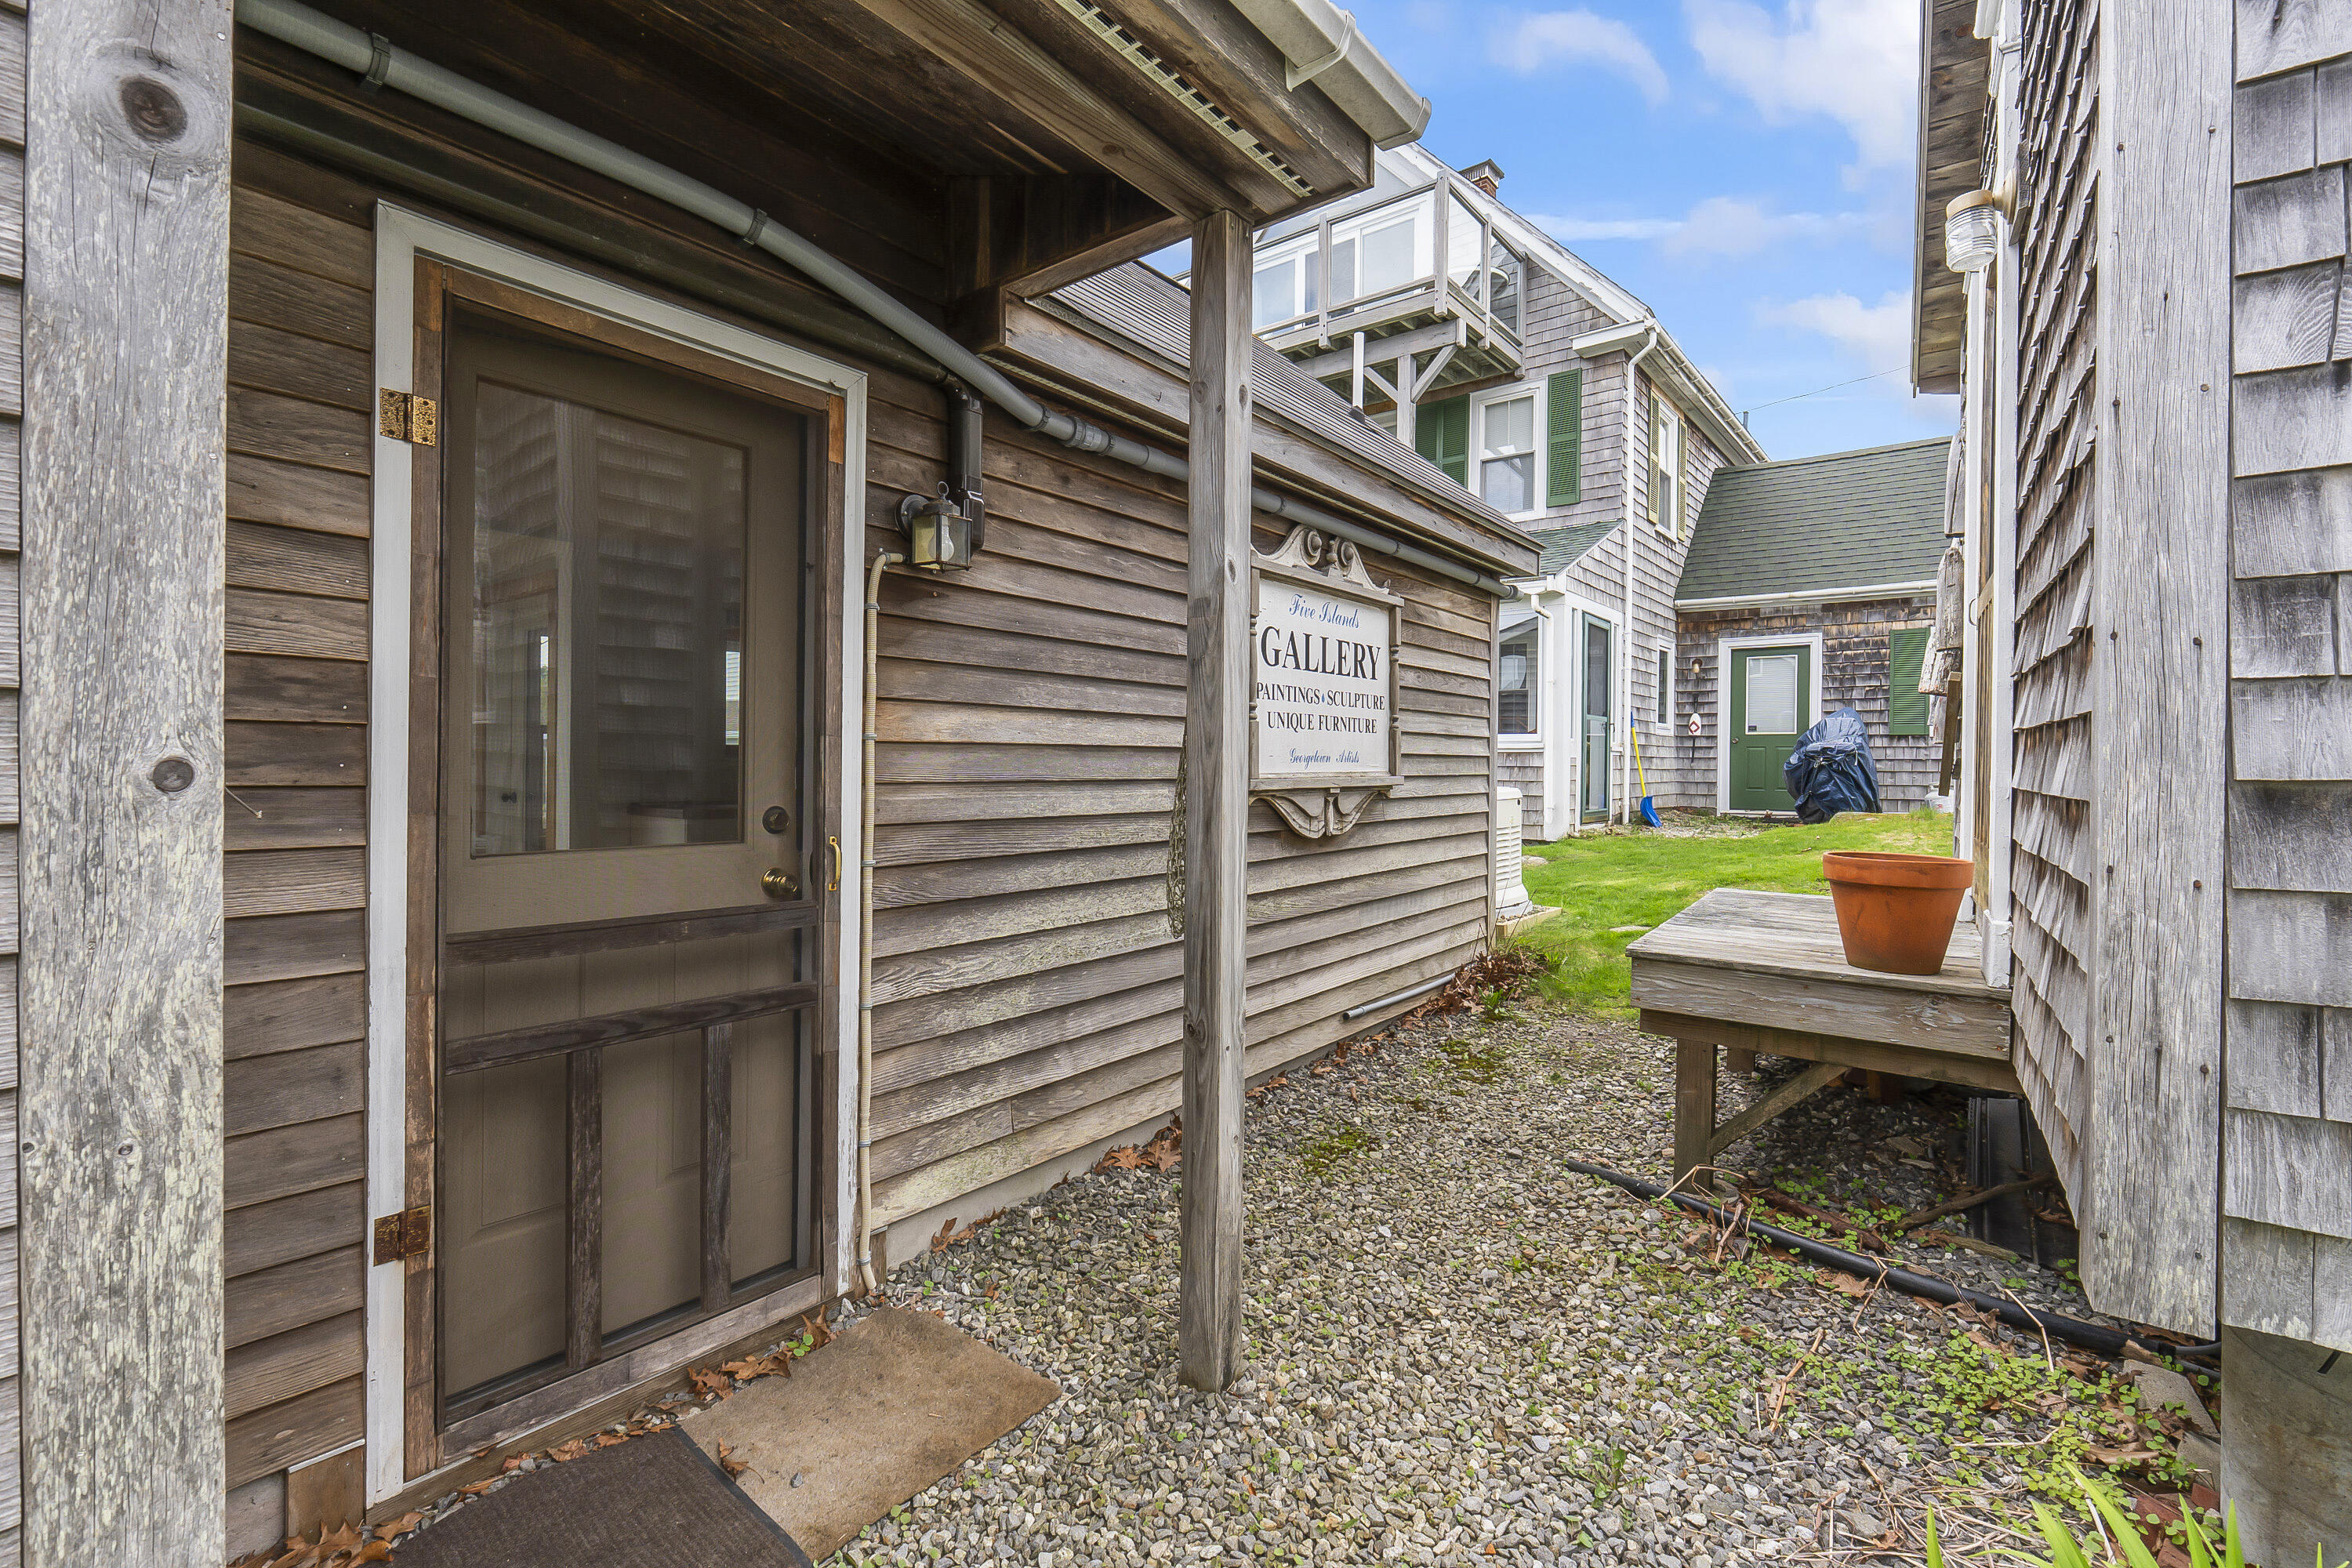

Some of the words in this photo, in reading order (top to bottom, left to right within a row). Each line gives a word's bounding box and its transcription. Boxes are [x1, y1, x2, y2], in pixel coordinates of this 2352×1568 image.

[1289, 593, 1316, 619] Five
[1319, 601, 1359, 628] Islands
[1261, 626, 1381, 681] GALLERY
[1256, 682, 1320, 704] PAINTINGS
[1327, 690, 1385, 710] SCULPTURE
[1267, 711, 1315, 733] UNIQUE
[1318, 714, 1377, 734] FURNITURE
[1289, 748, 1331, 770] Georgetown
[1335, 750, 1360, 764] Artists
